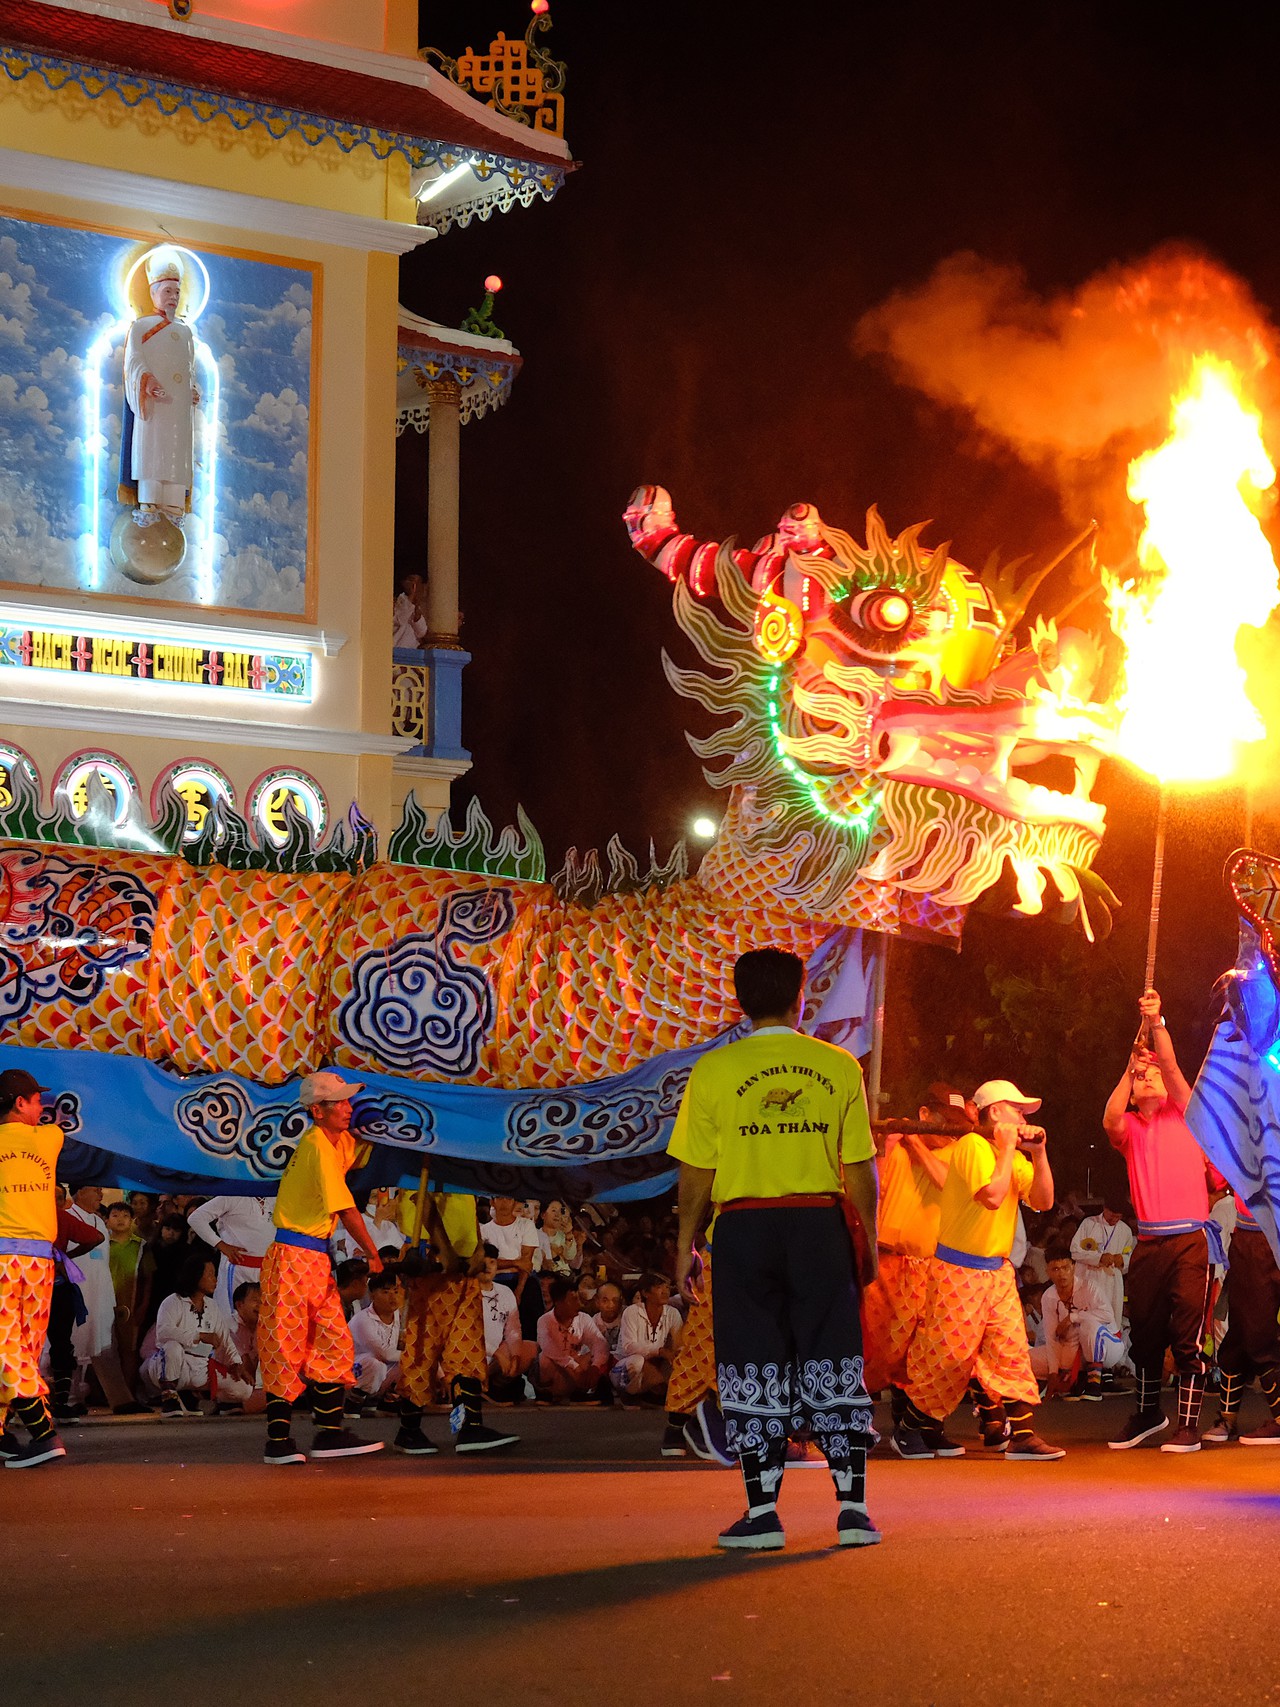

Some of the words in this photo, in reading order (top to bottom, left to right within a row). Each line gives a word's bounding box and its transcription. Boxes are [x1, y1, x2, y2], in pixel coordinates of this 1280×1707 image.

[153, 645, 204, 684] CHUNG
[736, 1074, 759, 1097] BAN
[739, 1122, 772, 1136] TÒA
[777, 1119, 830, 1134] THÁNH
